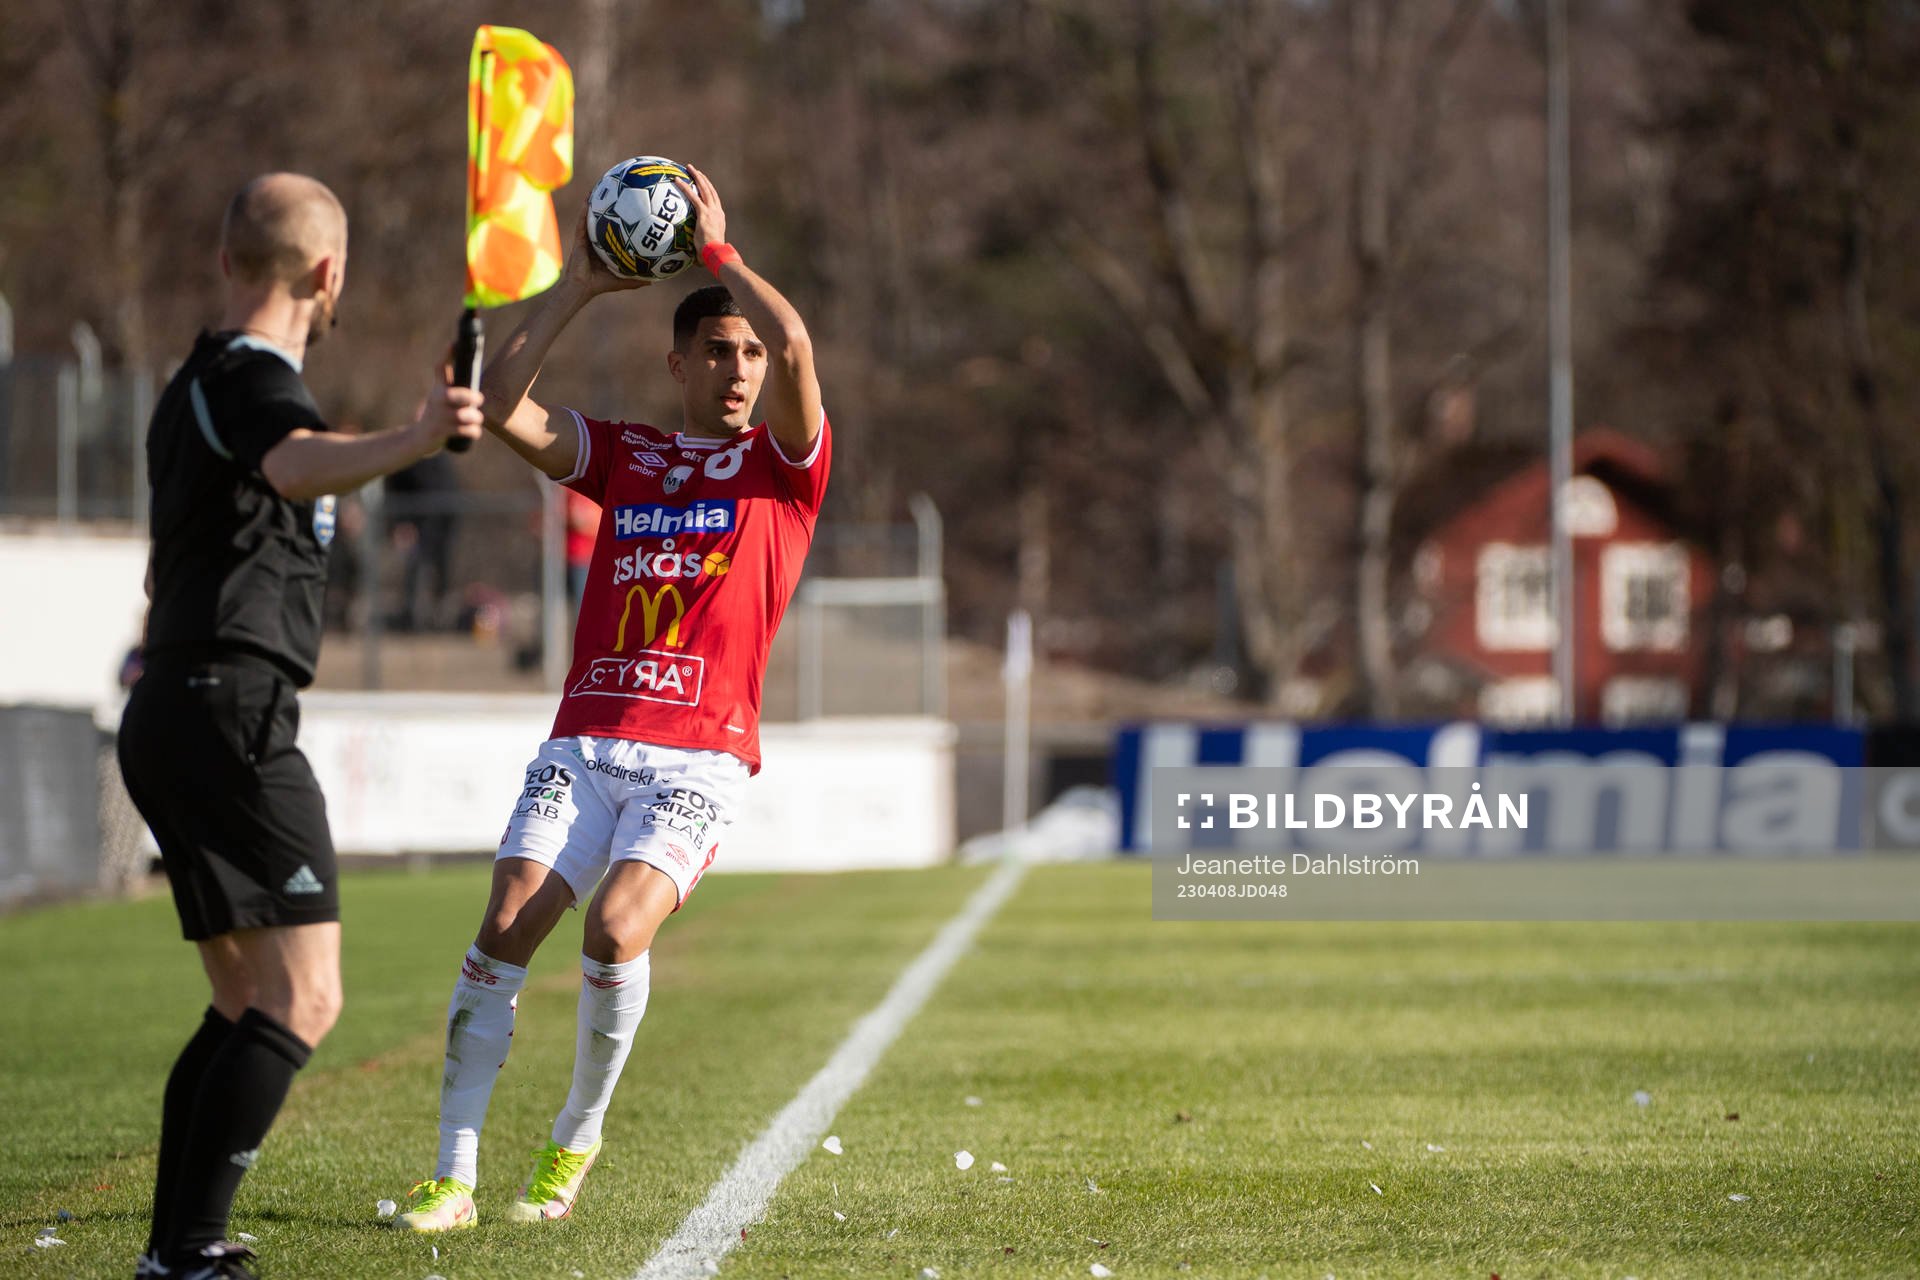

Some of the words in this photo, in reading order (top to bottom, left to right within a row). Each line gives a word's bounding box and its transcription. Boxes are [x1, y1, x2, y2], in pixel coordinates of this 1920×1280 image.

[641, 188, 681, 252] SELECT
[615, 503, 730, 536] Helmia
[525, 764, 571, 787] EOS
[1136, 721, 1844, 853] Helmia
